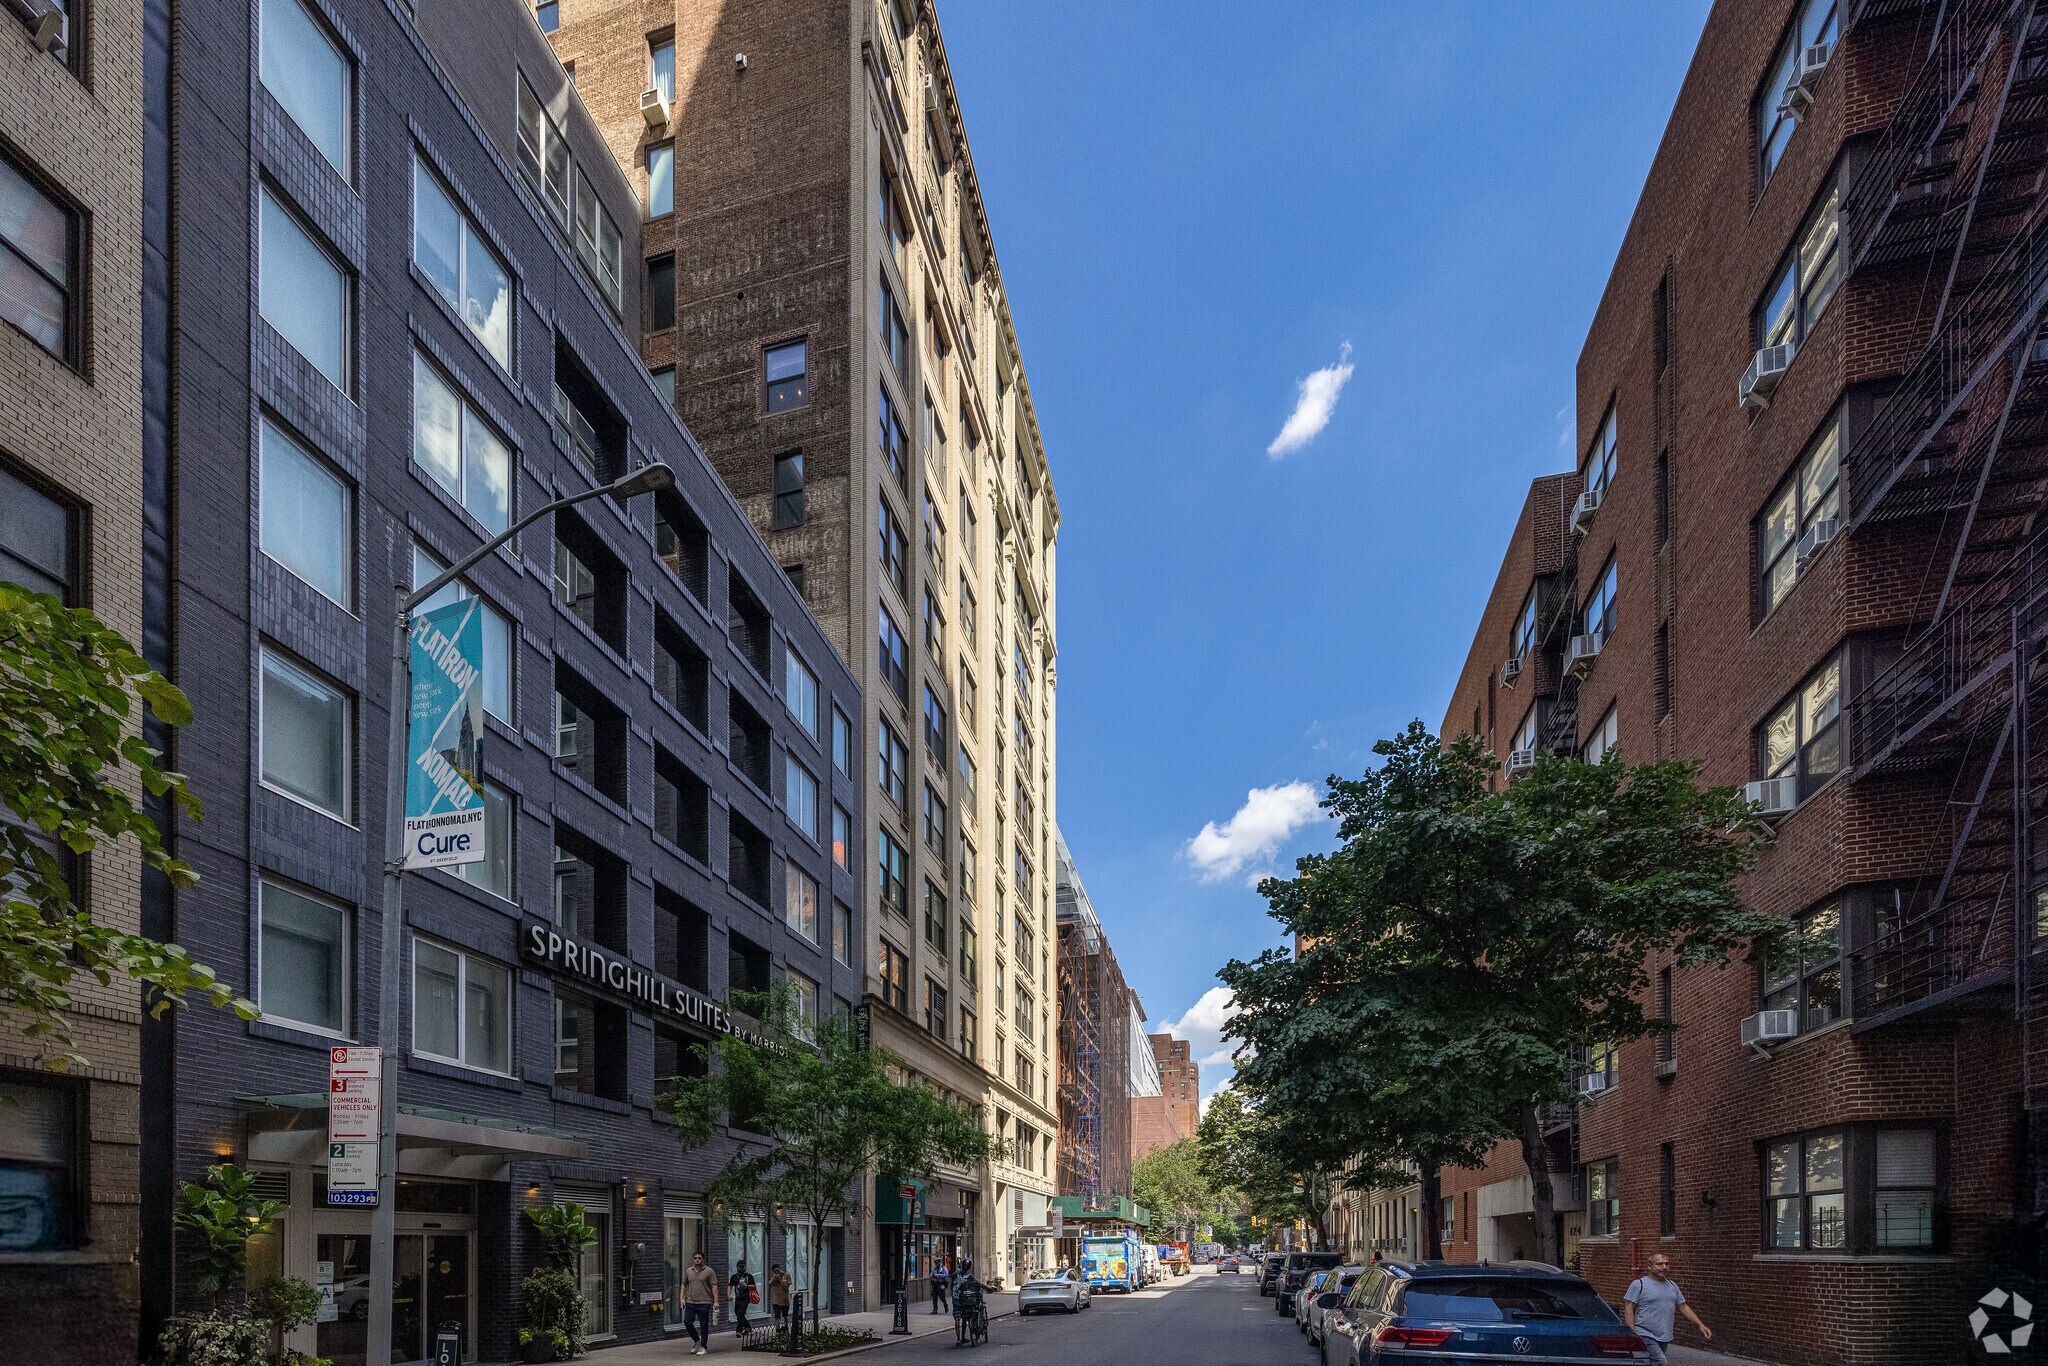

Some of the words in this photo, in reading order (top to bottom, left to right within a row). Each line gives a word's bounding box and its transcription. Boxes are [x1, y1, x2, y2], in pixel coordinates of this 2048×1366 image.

[412, 614, 479, 691] FLATIRON
[416, 747, 473, 810] NOMAD
[407, 811, 482, 830] FLATIRONNOMAD.NYC
[531, 925, 670, 1010] SPRINGHILL
[675, 989, 732, 1034] SUITES
[734, 1026, 746, 1040] BY
[750, 1032, 790, 1058] MARRIOT
[335, 1080, 344, 1092] 3
[333, 1144, 342, 1157] 2
[1570, 1226, 1581, 1236] 124
[440, 1342, 450, 1366] LO
